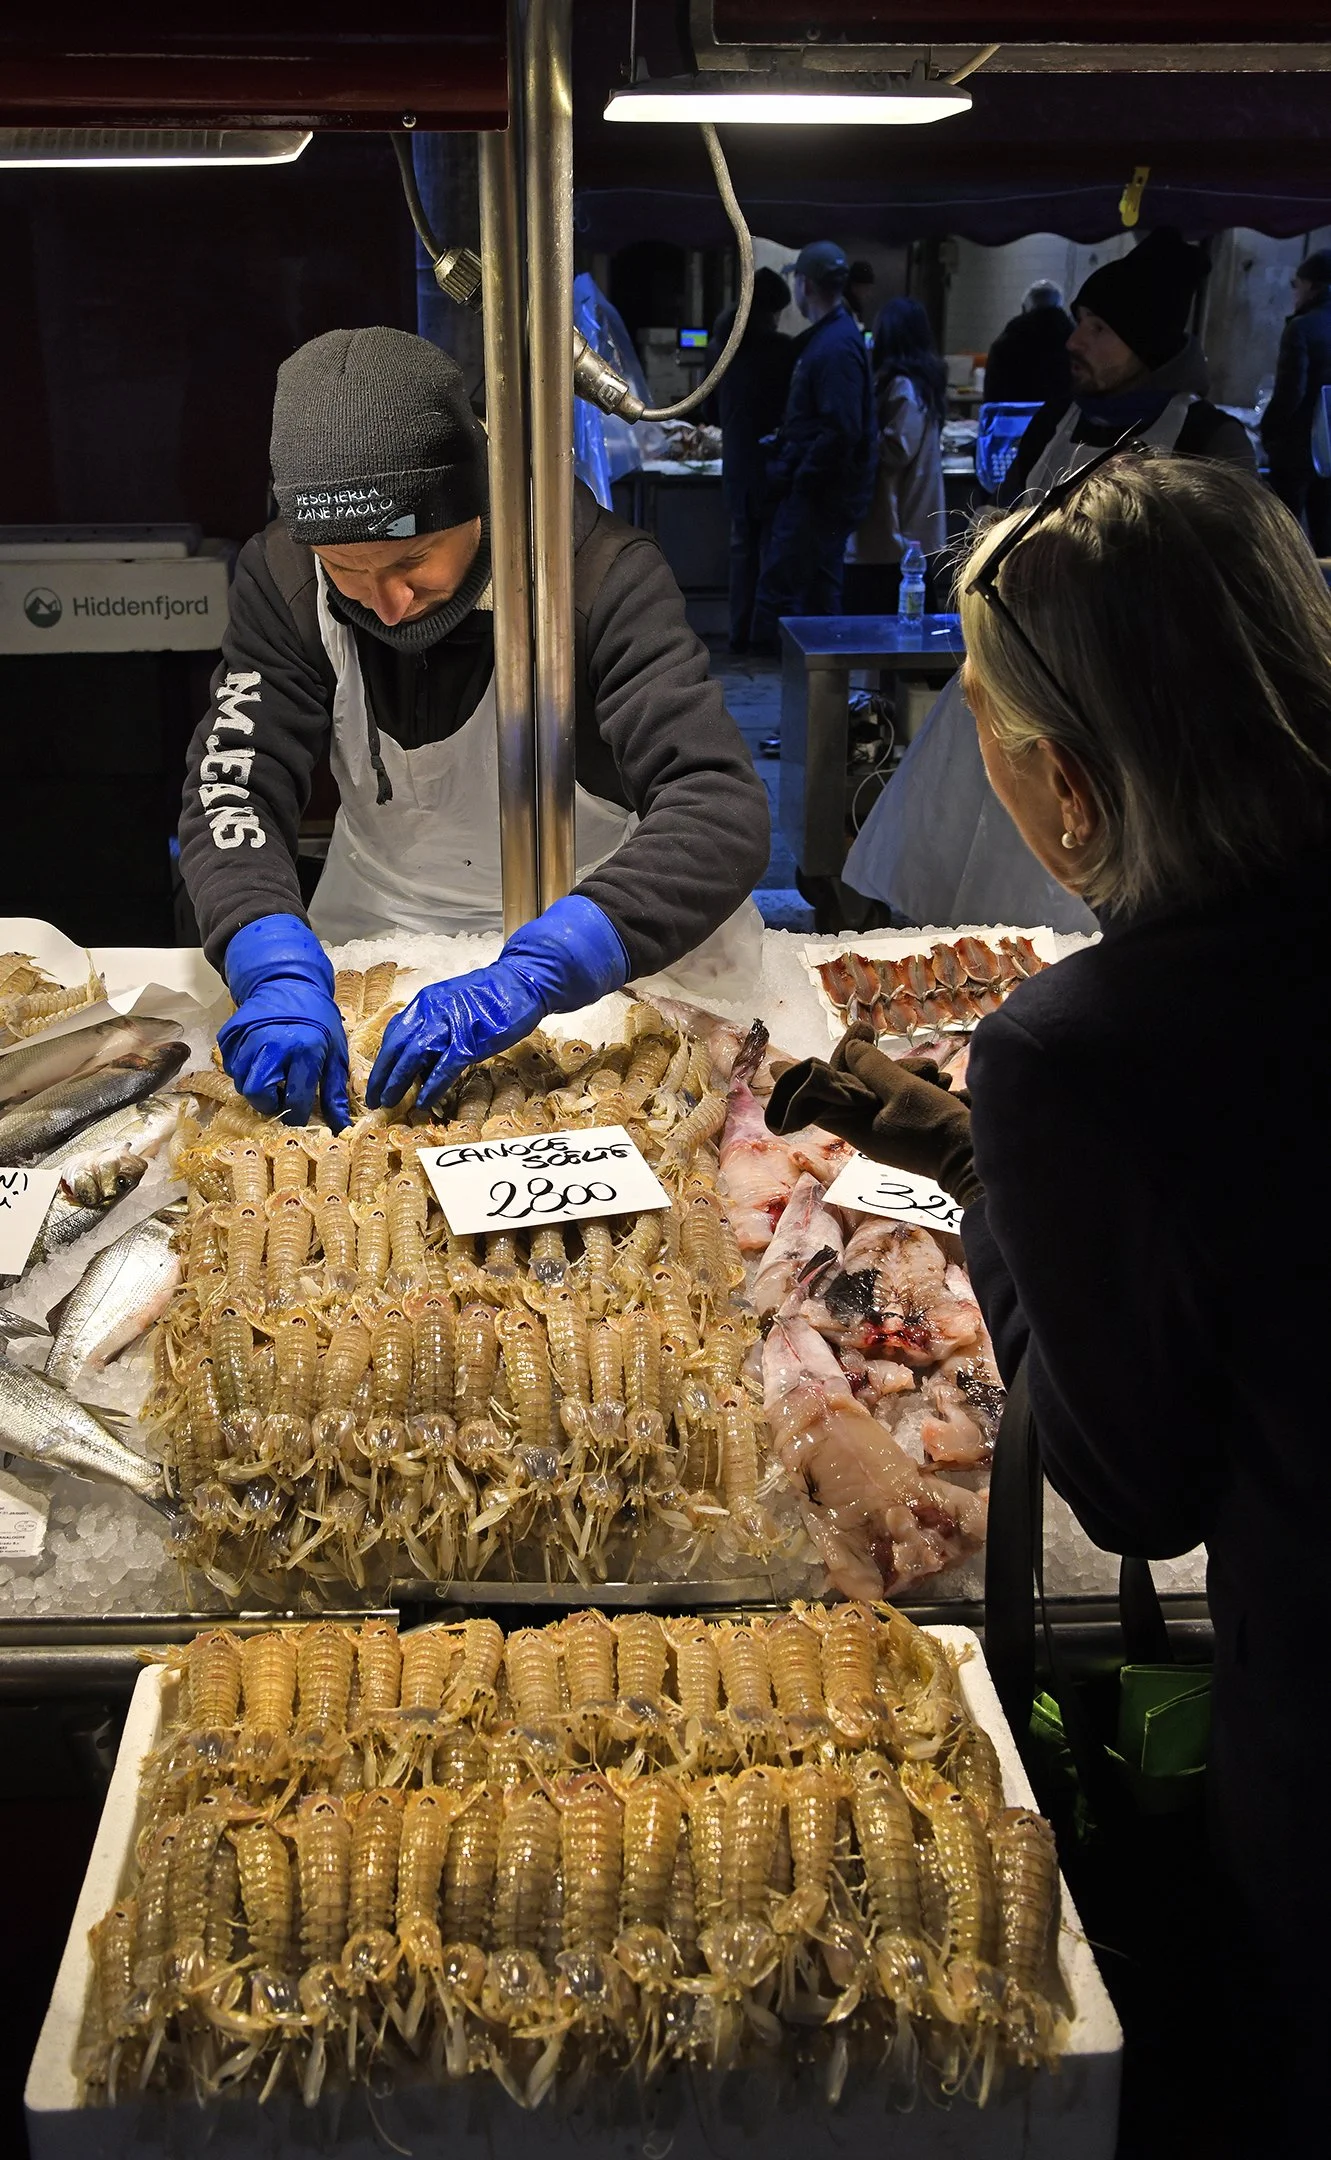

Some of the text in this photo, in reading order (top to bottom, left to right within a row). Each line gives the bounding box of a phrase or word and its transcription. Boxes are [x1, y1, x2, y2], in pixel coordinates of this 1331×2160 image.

[335, 498, 393, 517] PAOLO
[72, 595, 209, 620] Hiddenfjord
[435, 1137, 571, 1167] CANOCE
